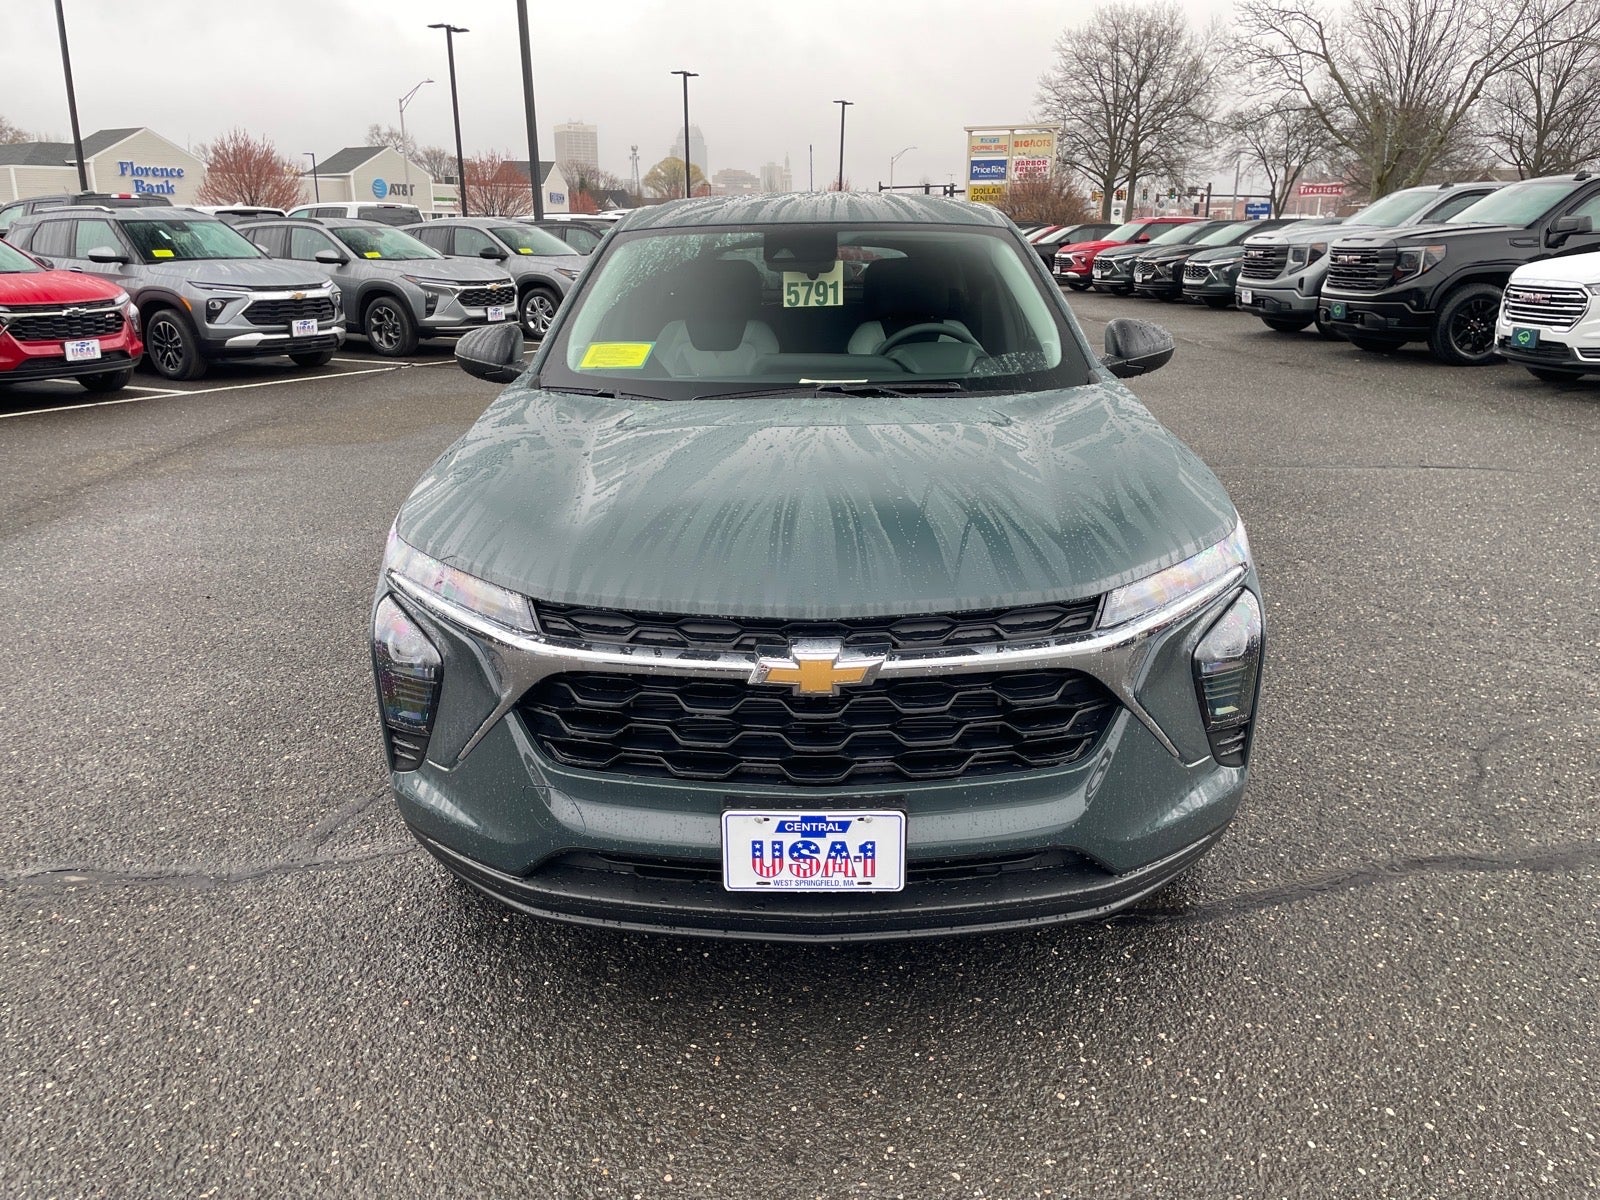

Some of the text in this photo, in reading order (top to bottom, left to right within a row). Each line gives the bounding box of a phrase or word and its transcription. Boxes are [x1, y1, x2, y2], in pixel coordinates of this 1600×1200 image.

[118, 161, 185, 178] Florence
[133, 179, 176, 195] Bank
[389, 183, 415, 197] AT&T
[1299, 184, 1343, 194] Firestone
[786, 281, 838, 306] 5791
[784, 822, 843, 832] CENTRAL
